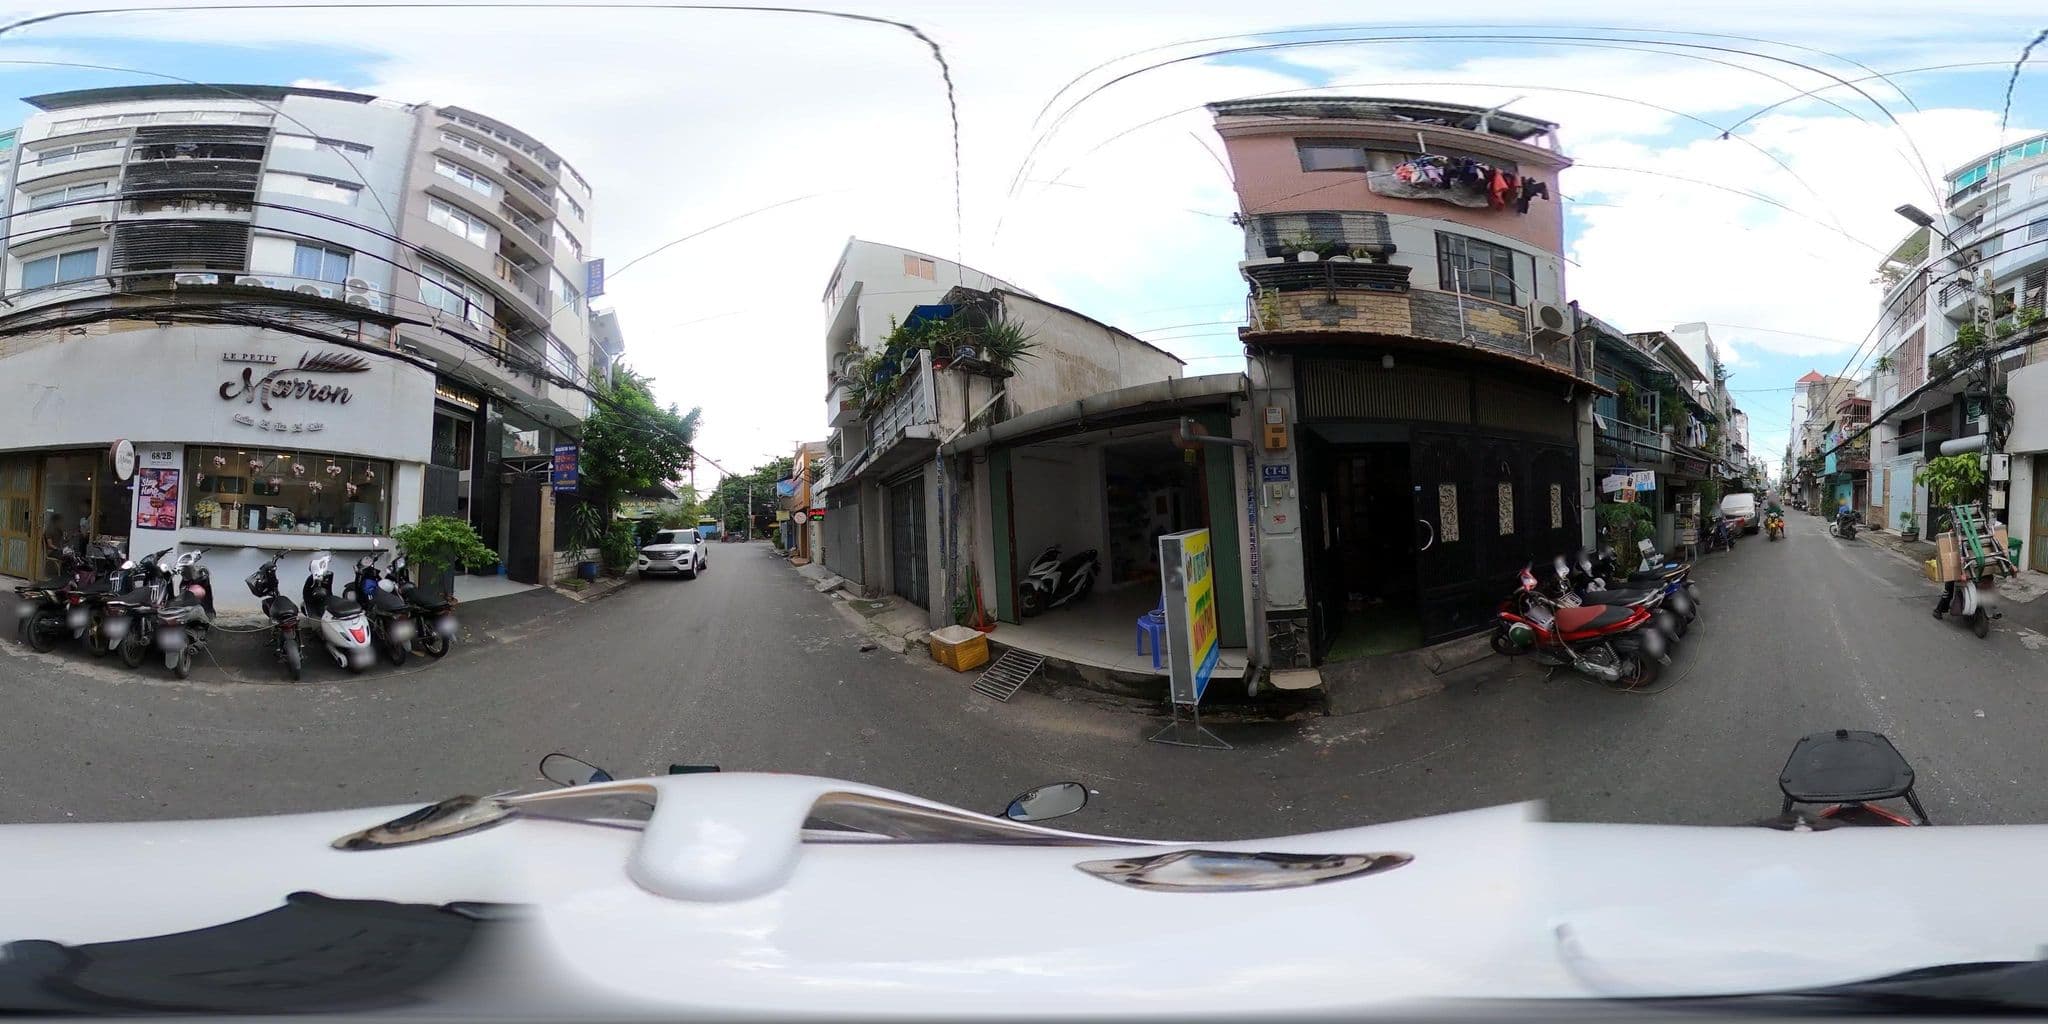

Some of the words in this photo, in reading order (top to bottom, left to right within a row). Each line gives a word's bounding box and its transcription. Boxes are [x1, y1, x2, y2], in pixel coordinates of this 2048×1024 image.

[223, 352, 235, 360] LE
[242, 353, 277, 362] PETIT
[219, 367, 353, 411] Marron
[151, 451, 172, 460] 68/2B
